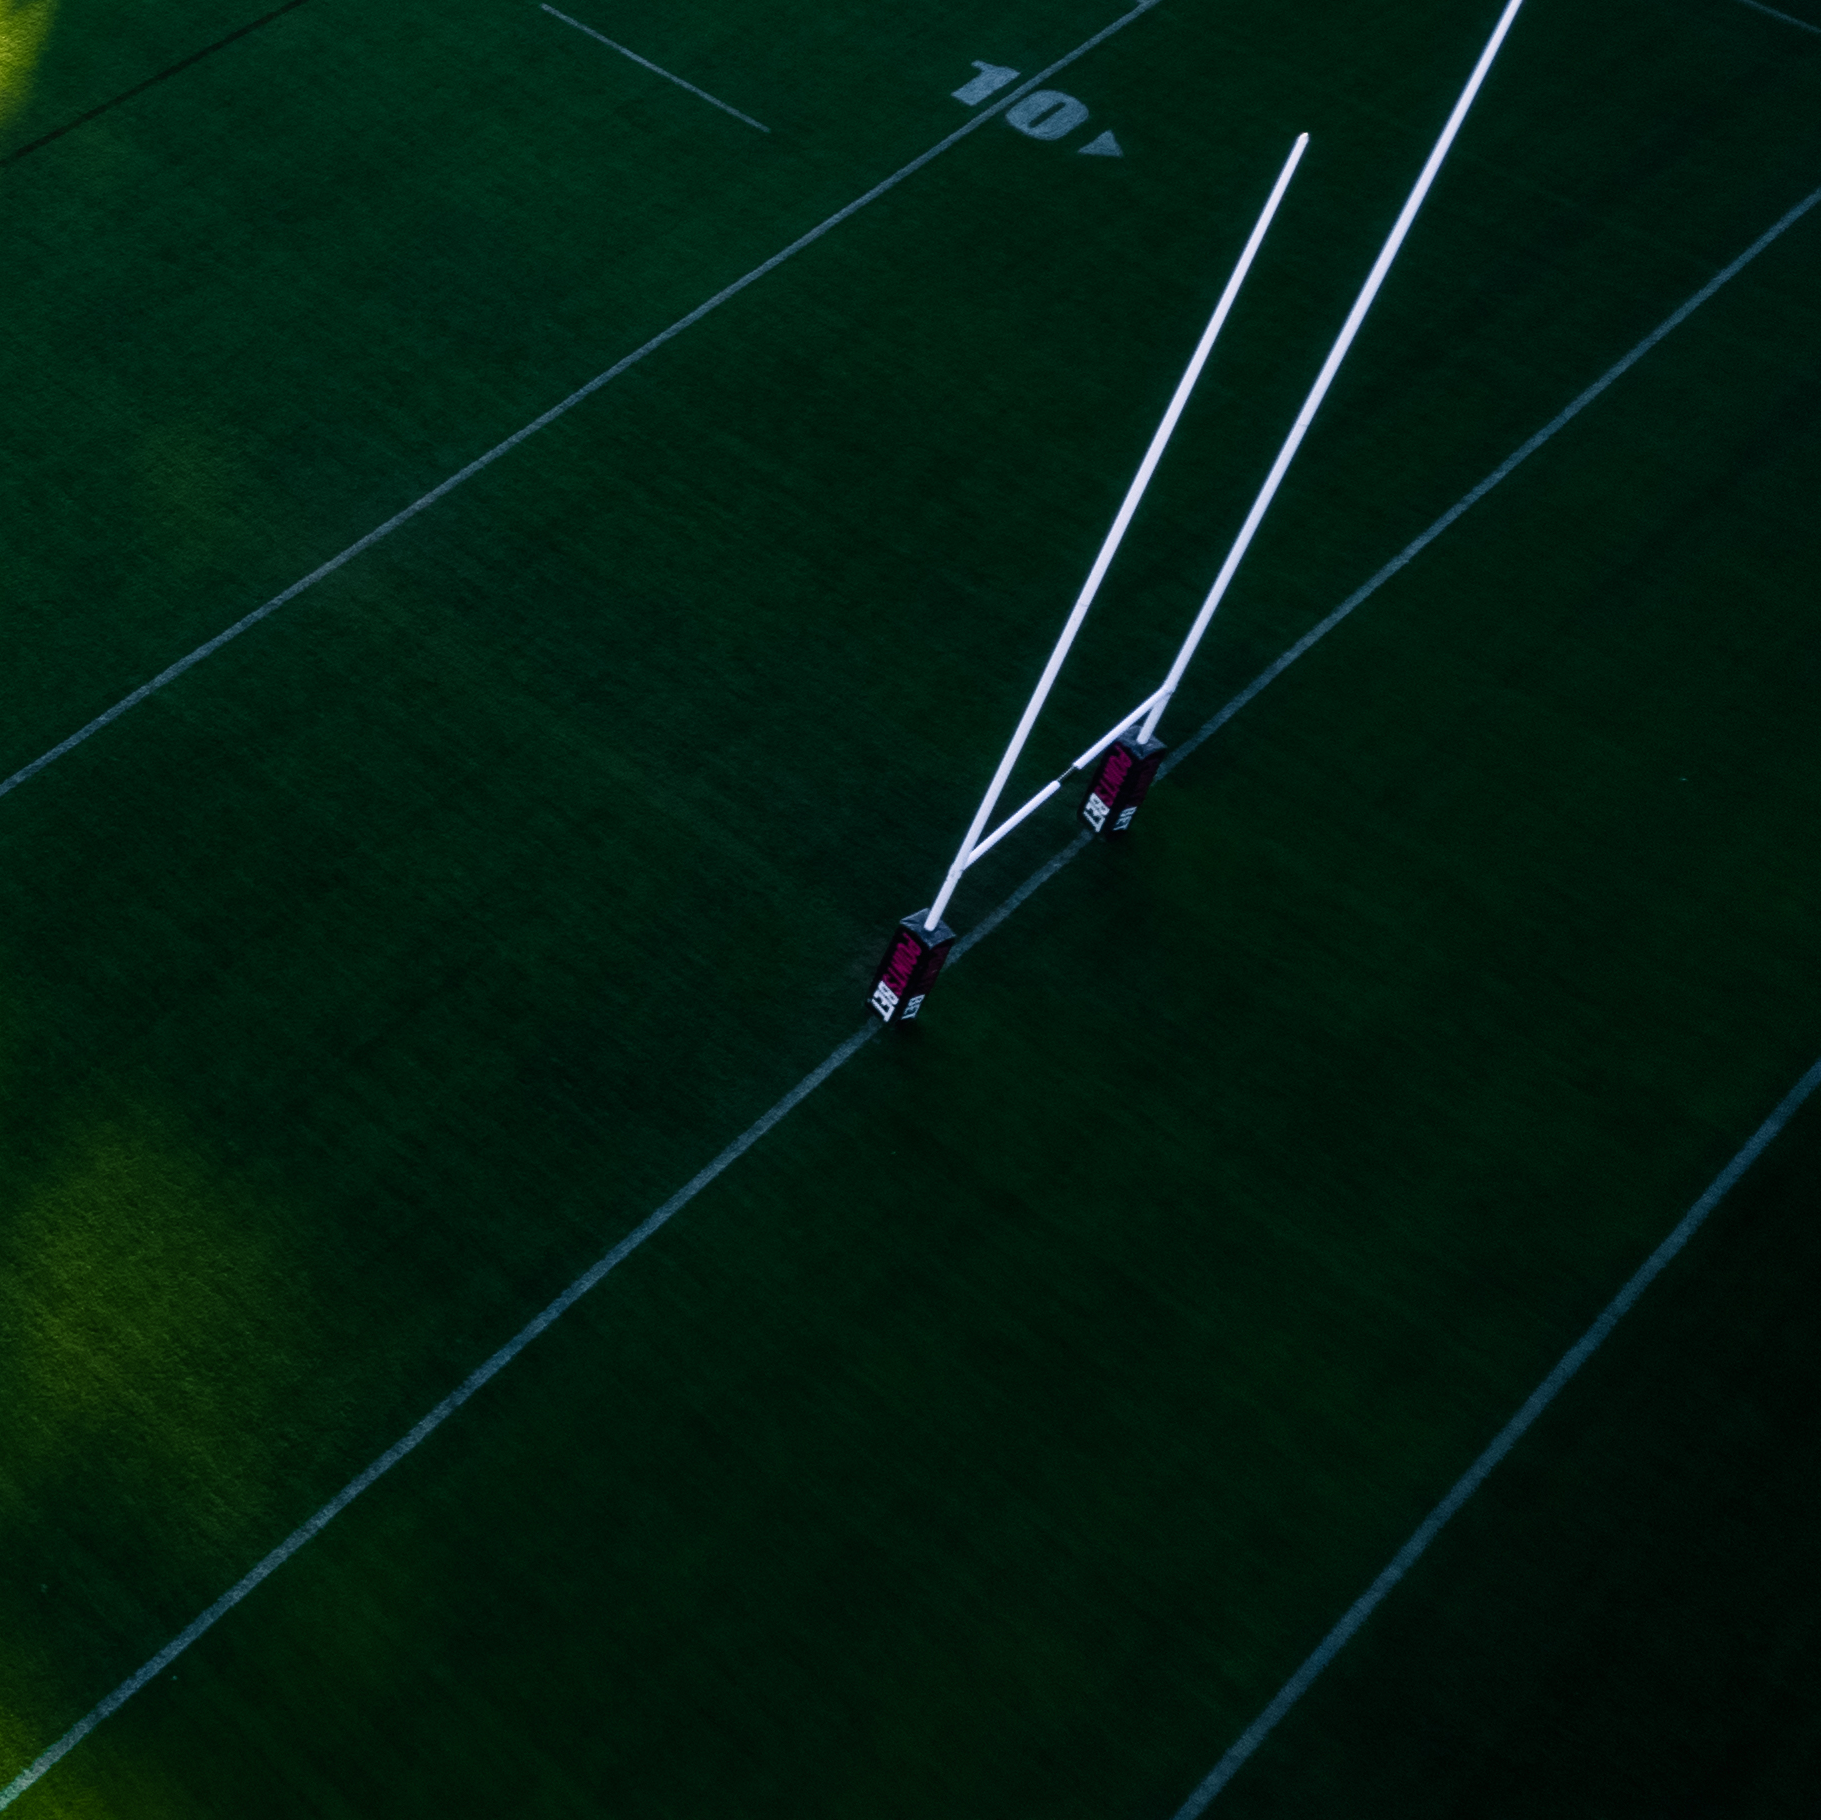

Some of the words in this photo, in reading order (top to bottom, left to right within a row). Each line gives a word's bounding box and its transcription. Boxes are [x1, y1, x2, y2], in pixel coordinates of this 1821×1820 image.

[951, 60, 1090, 141] 10
[1082, 743, 1132, 833] POINTSBET
[871, 932, 922, 1023] POINTSBET
